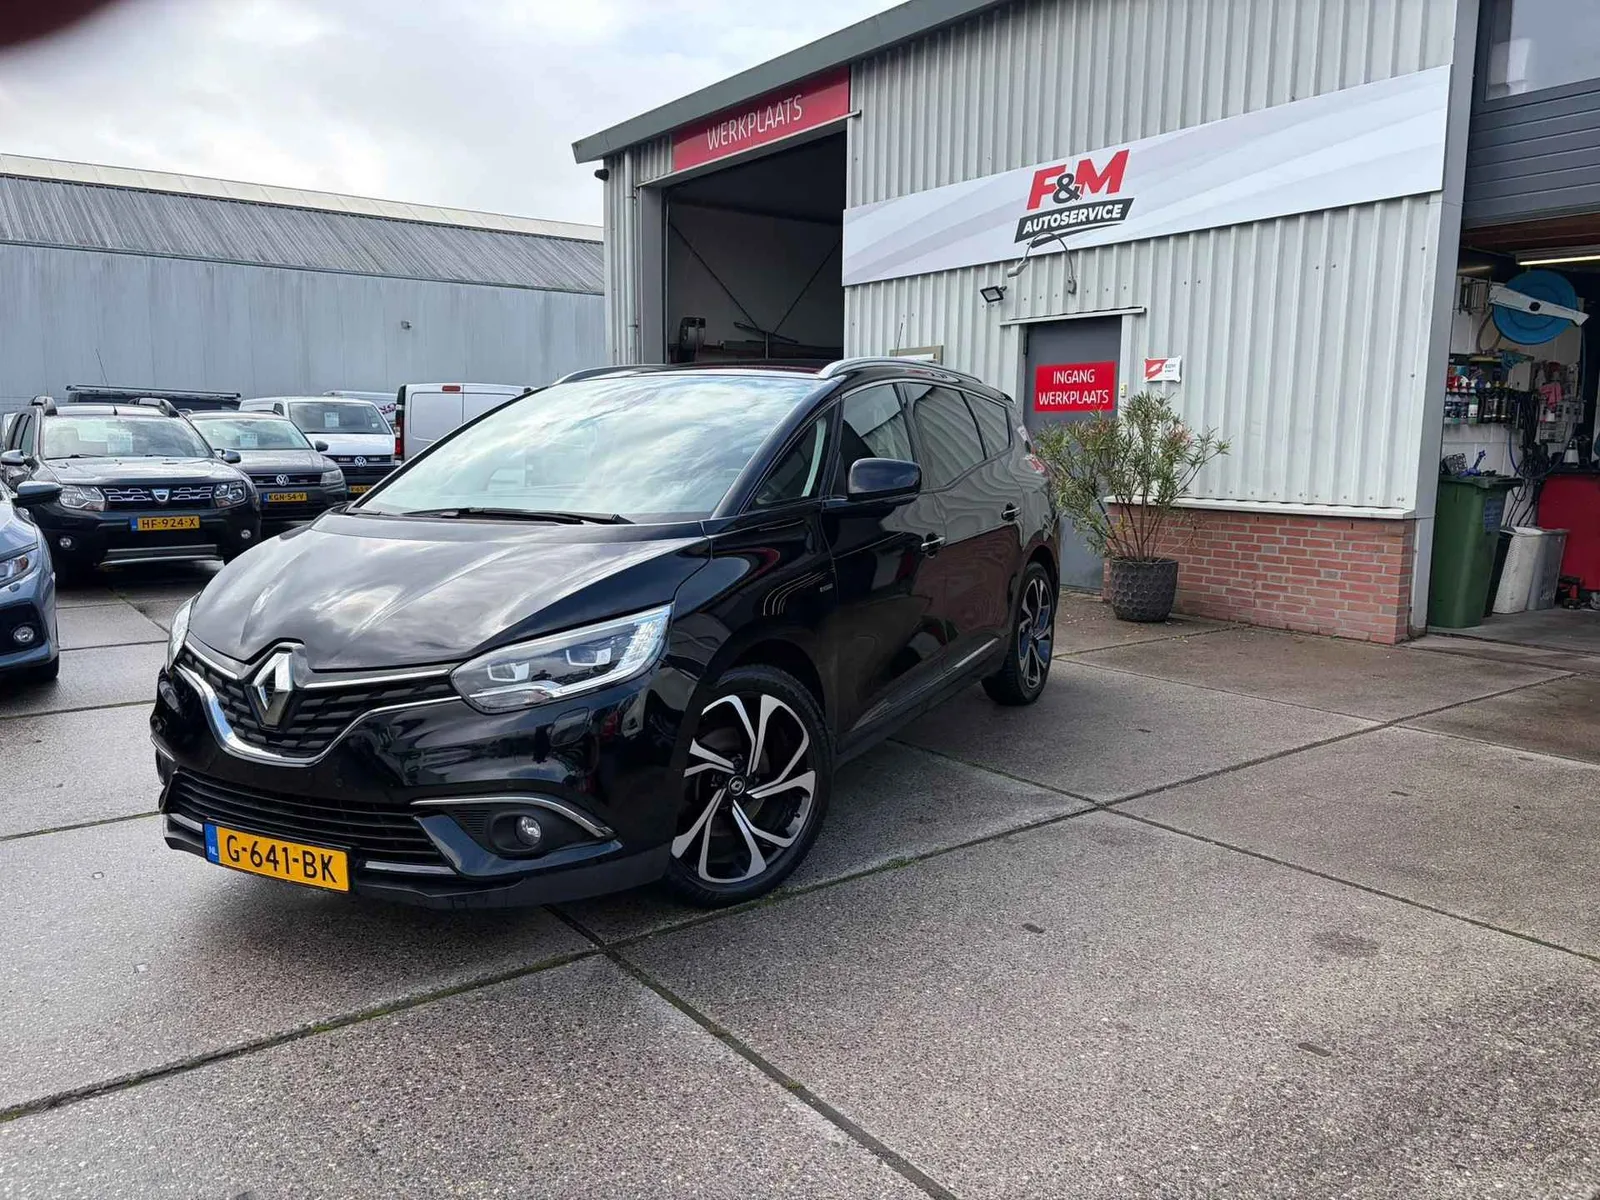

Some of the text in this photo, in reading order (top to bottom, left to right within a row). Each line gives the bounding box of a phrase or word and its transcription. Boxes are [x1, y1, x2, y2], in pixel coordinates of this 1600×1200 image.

[707, 94, 802, 150] WERKPLAATS
[1027, 149, 1129, 210] F&M
[1022, 204, 1124, 235] AUTOSERVICE
[1053, 368, 1096, 385] INGANG
[1038, 389, 1109, 406] WERKPLAATS
[142, 517, 196, 529] HF-924-X
[226, 833, 338, 884] G-641-BK
